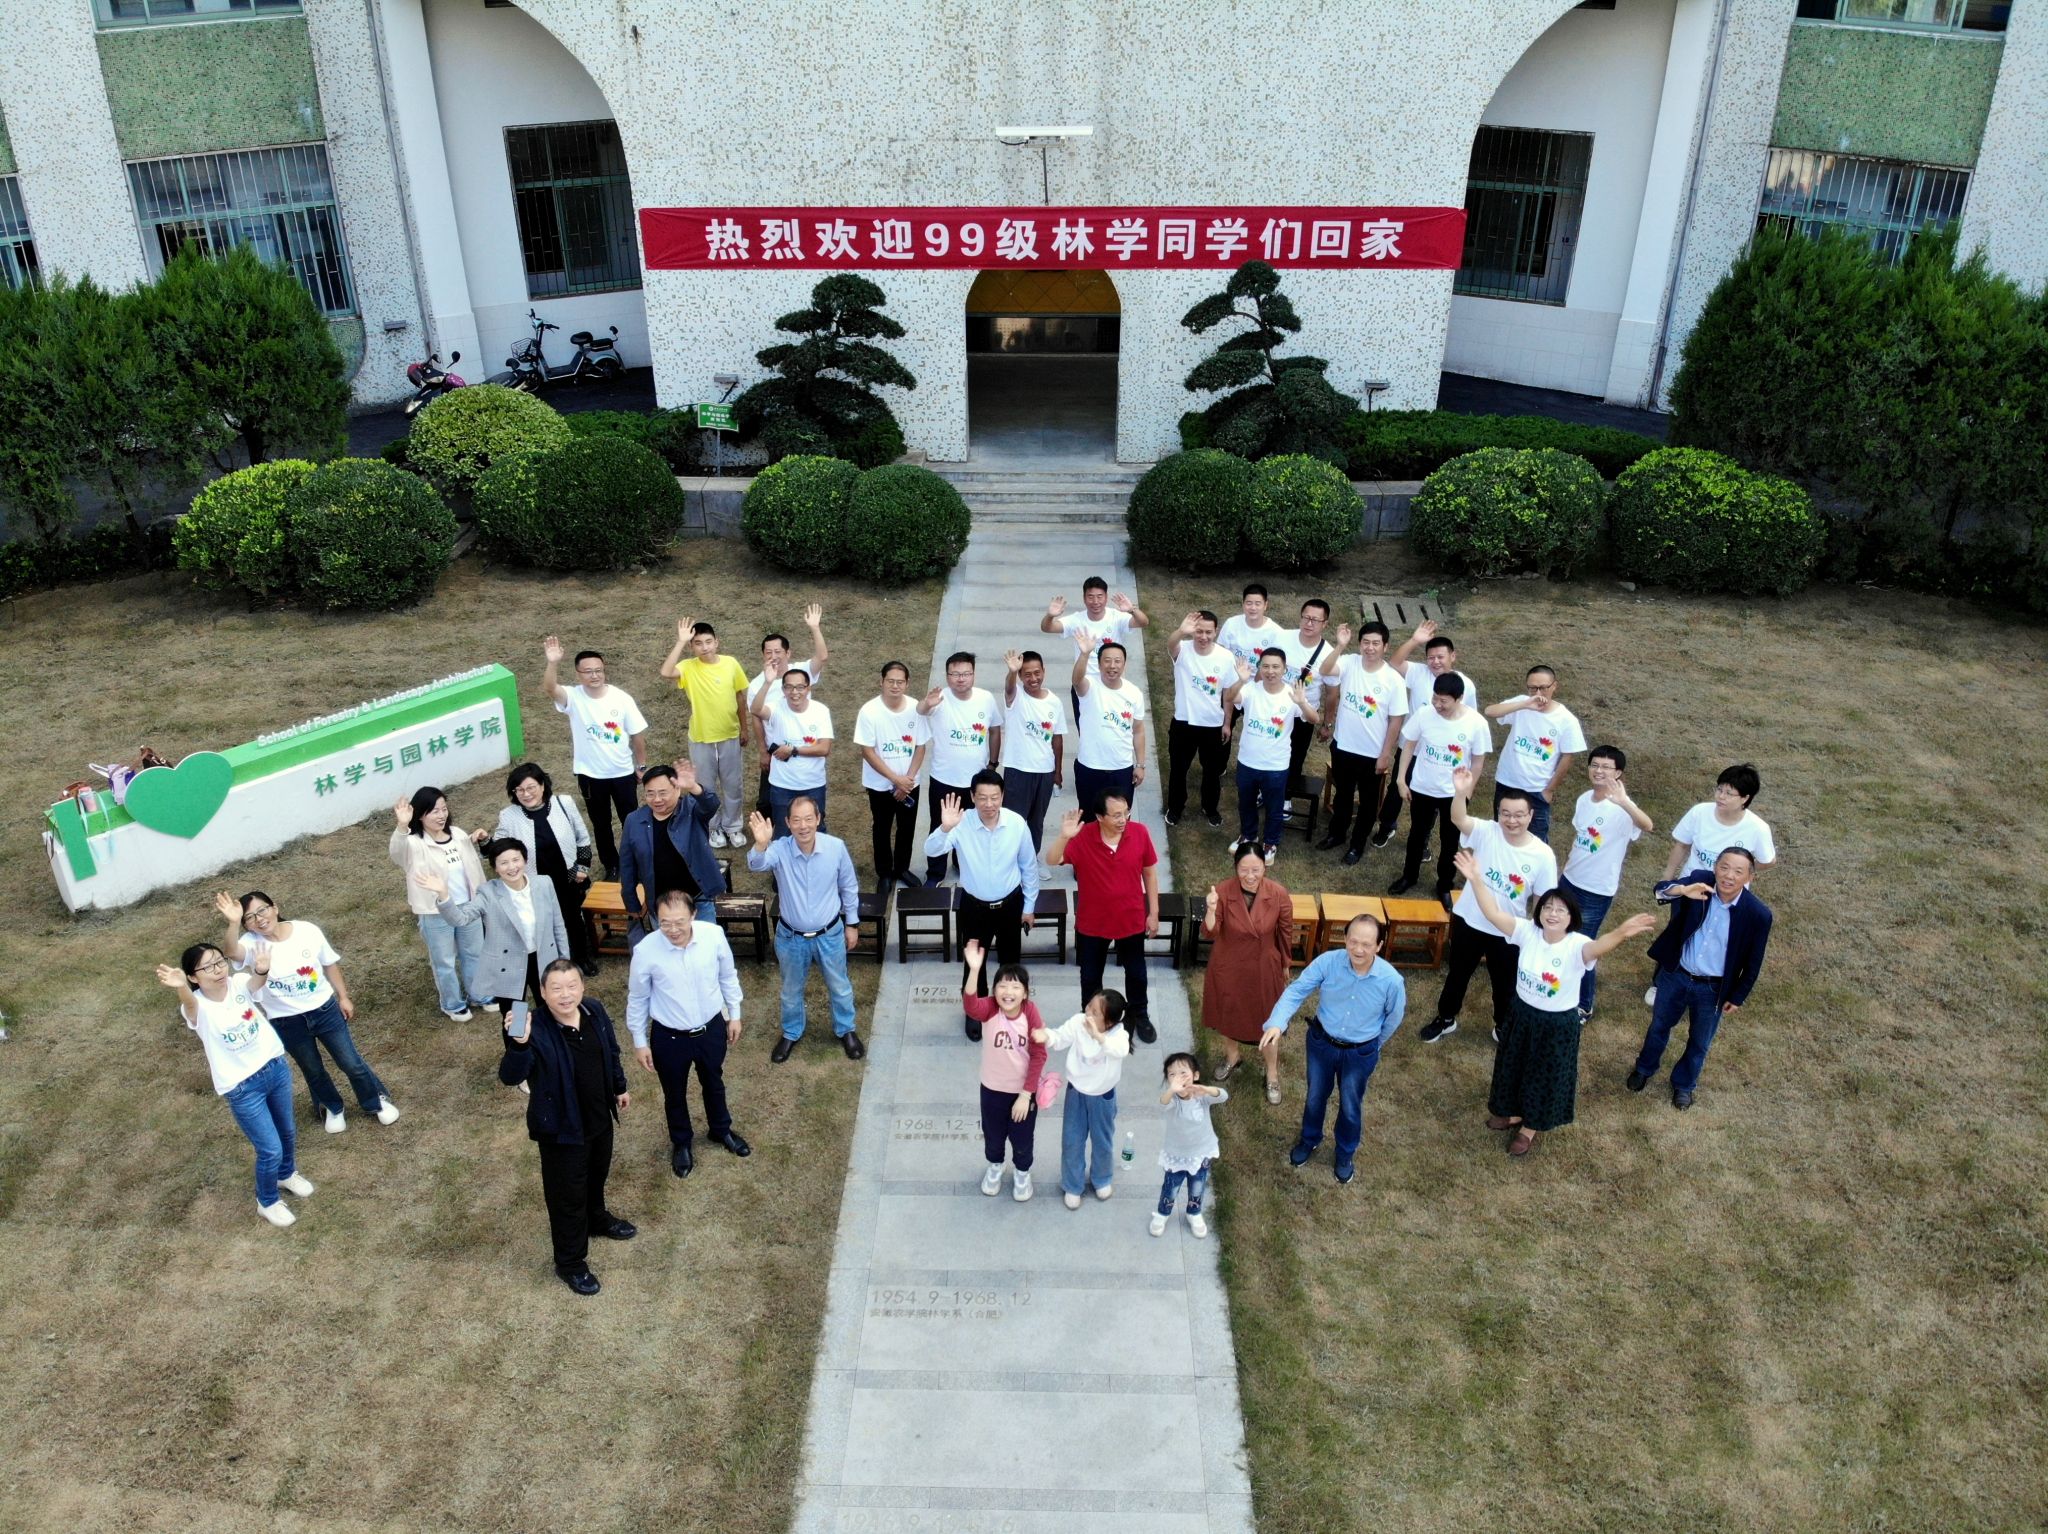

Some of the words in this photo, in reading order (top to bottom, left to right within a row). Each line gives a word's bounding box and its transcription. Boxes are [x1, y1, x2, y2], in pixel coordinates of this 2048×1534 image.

[705, 217, 1404, 261] 热烈欢迎99级林学同学们回家
[257, 725, 298, 747] School
[301, 719, 311, 733] of
[313, 706, 360, 728] Forestry
[361, 701, 371, 712] &
[373, 685, 431, 709] Landscape
[432, 664, 494, 690] Architecture
[314, 716, 501, 797] 林学与园林学院
